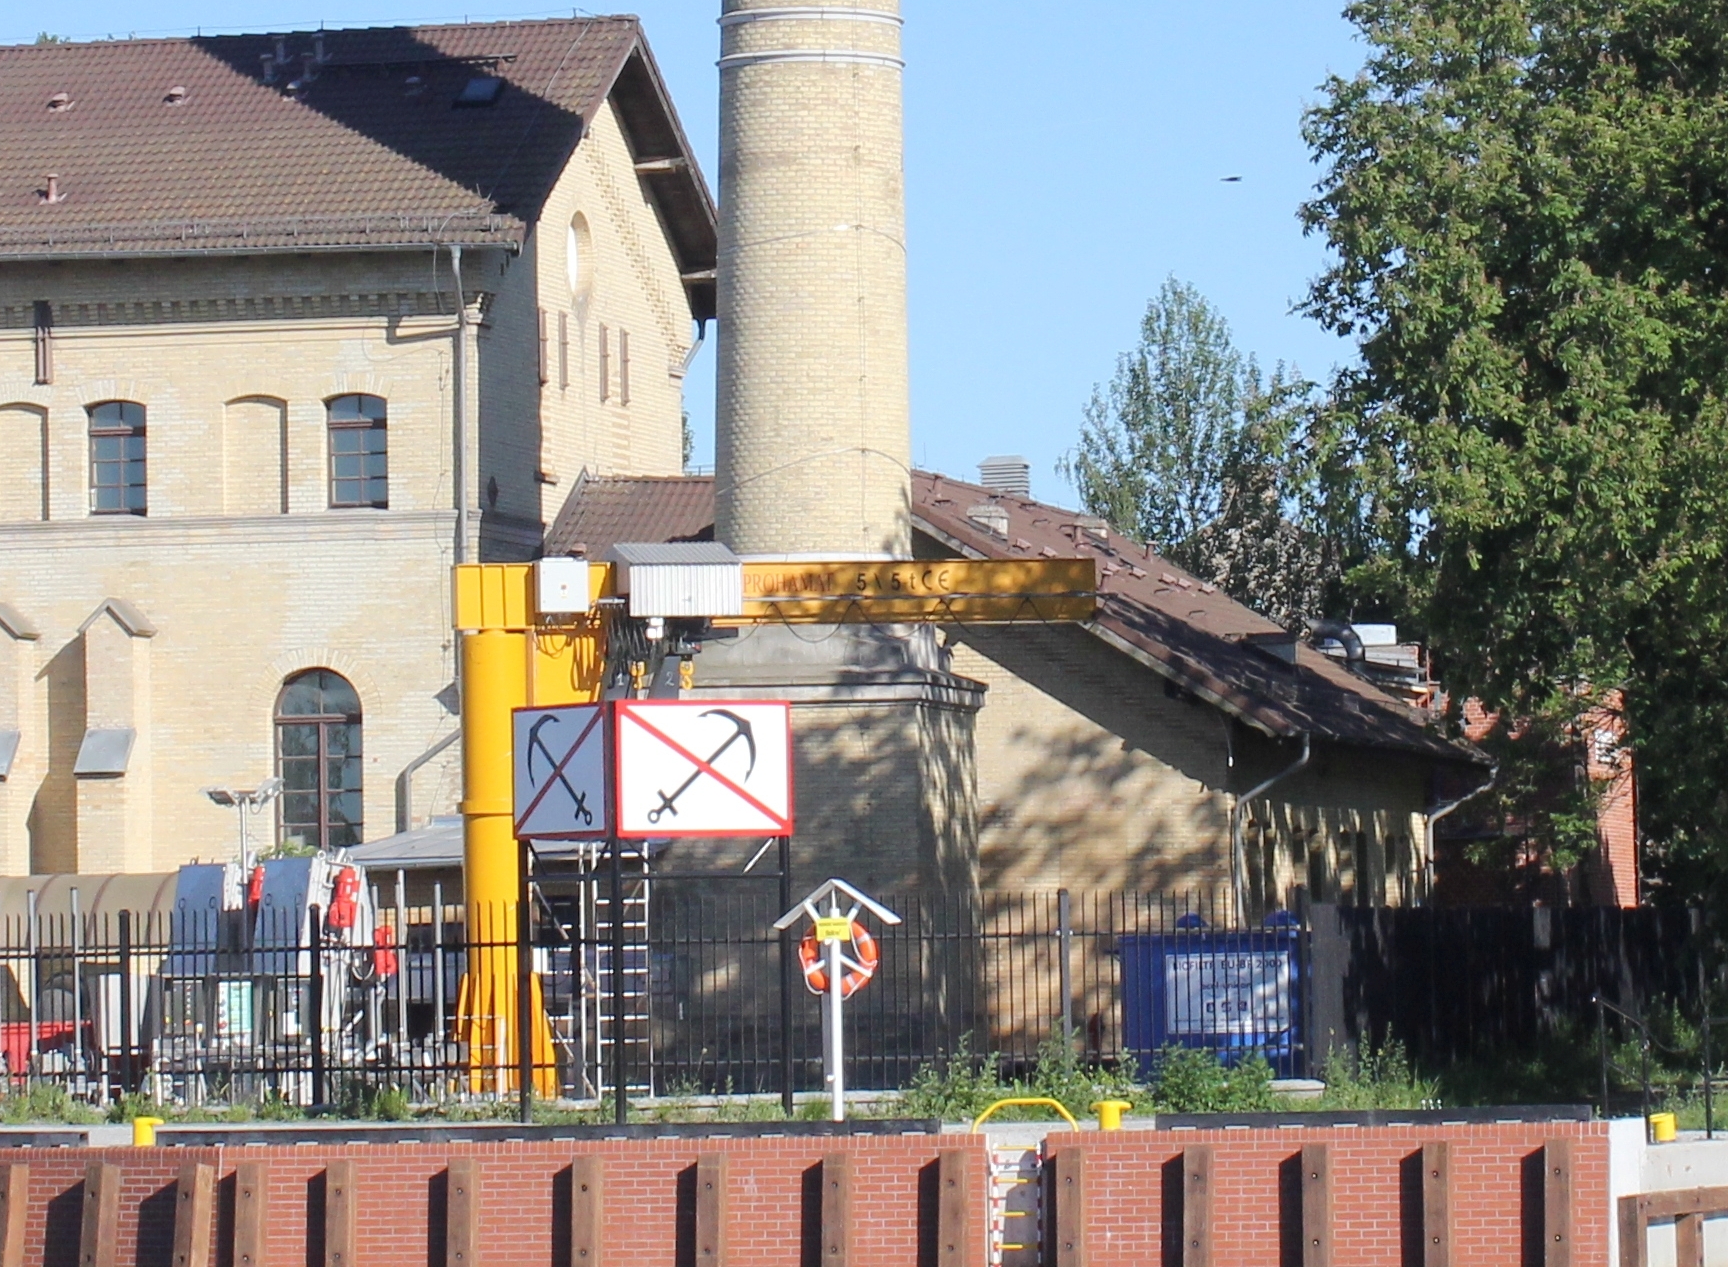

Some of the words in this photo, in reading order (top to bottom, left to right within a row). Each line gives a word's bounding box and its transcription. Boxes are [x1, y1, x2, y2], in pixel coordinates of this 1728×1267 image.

[742, 572, 835, 593] PROHAMAT
[616, 673, 625, 686] 1
[664, 671, 675, 687] 2
